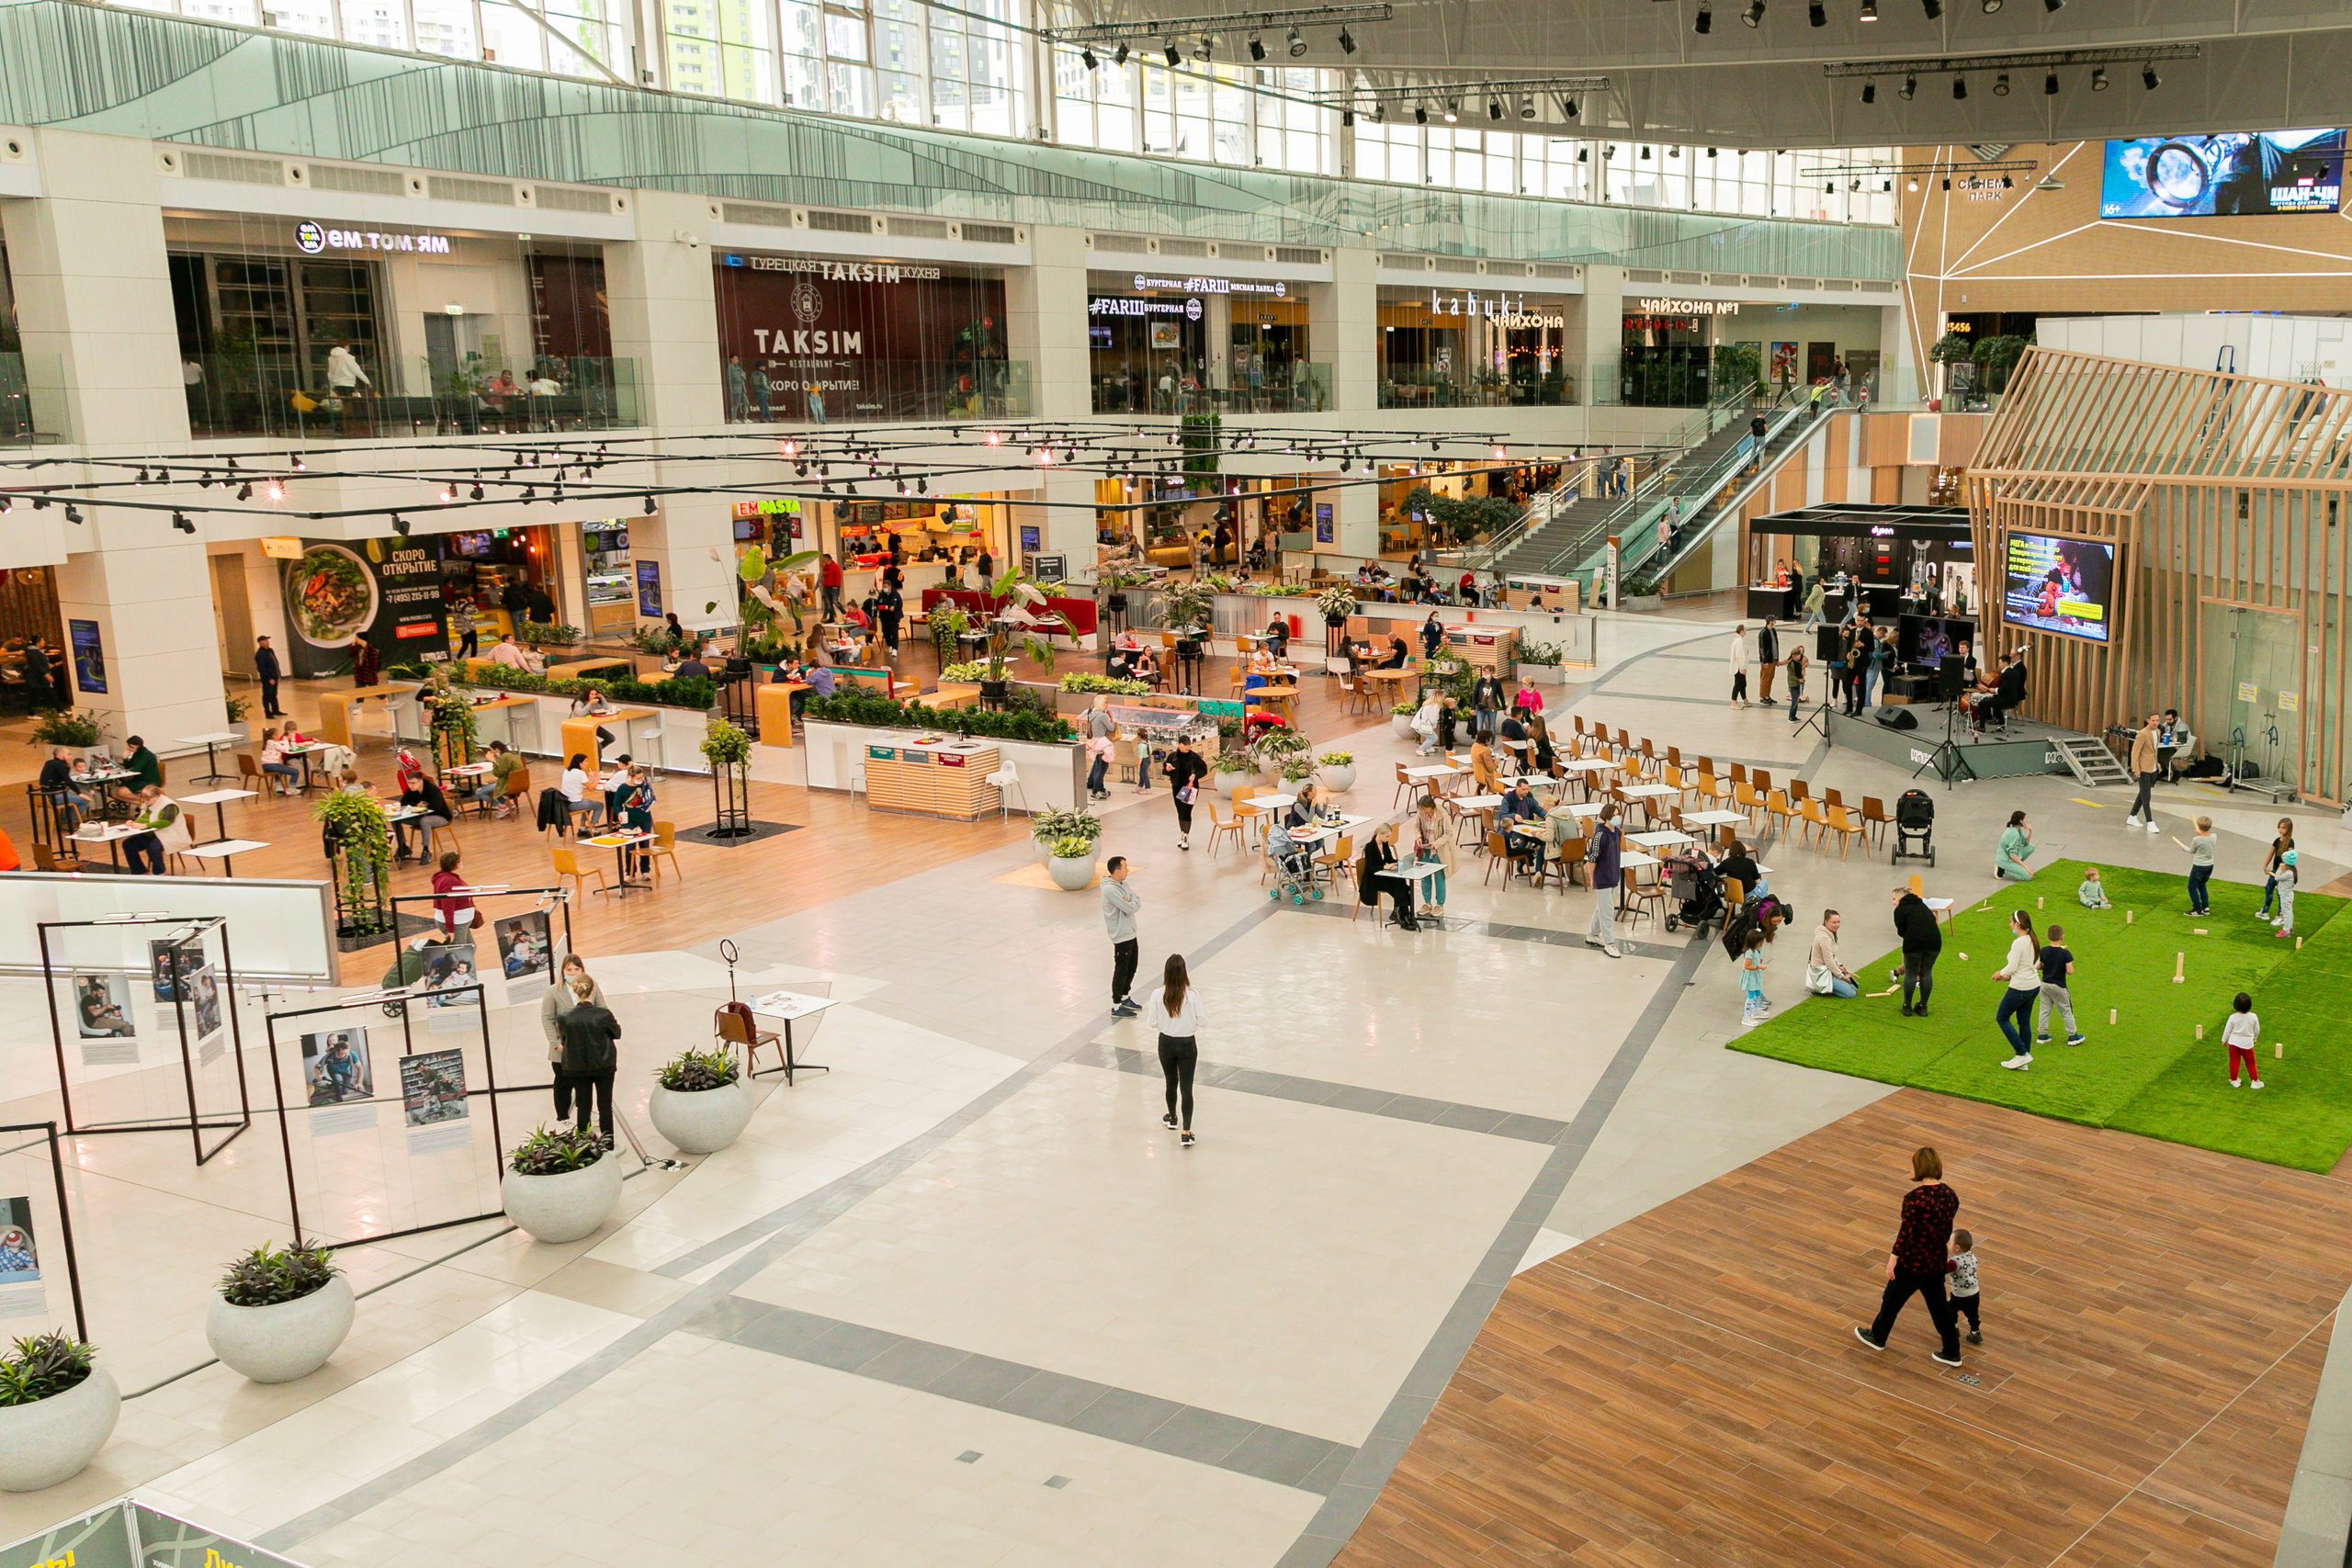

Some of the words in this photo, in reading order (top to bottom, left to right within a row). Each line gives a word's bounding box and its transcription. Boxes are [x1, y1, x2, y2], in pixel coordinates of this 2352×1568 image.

[1969, 191, 2002, 201] ПАРК
[2104, 203, 2121, 215] 16+
[750, 256, 816, 274] ТУРЕЦКАЯ
[820, 261, 900, 284] TAKSIM
[903, 266, 940, 279] КУХНЯ
[1146, 278, 1182, 288] БУРГЕРНАЯ
[1144, 303, 1184, 313] БУРГЕРНАЯ
[1431, 289, 1524, 317] kabuki
[1640, 298, 1713, 314] ЧАЙХОНА
[1490, 315, 1564, 328] ЧАЙХОНА
[753, 329, 862, 355] TAKSIM
[789, 359, 832, 368] RESTAURANT
[770, 379, 798, 391] КОРО
[1871, 525, 1894, 536] dyson
[392, 548, 425, 562] СКОРО
[382, 560, 437, 576] ОТКРЫТИЕ
[393, 592, 411, 604] (495)
[411, 590, 440, 601] 215-11-99
